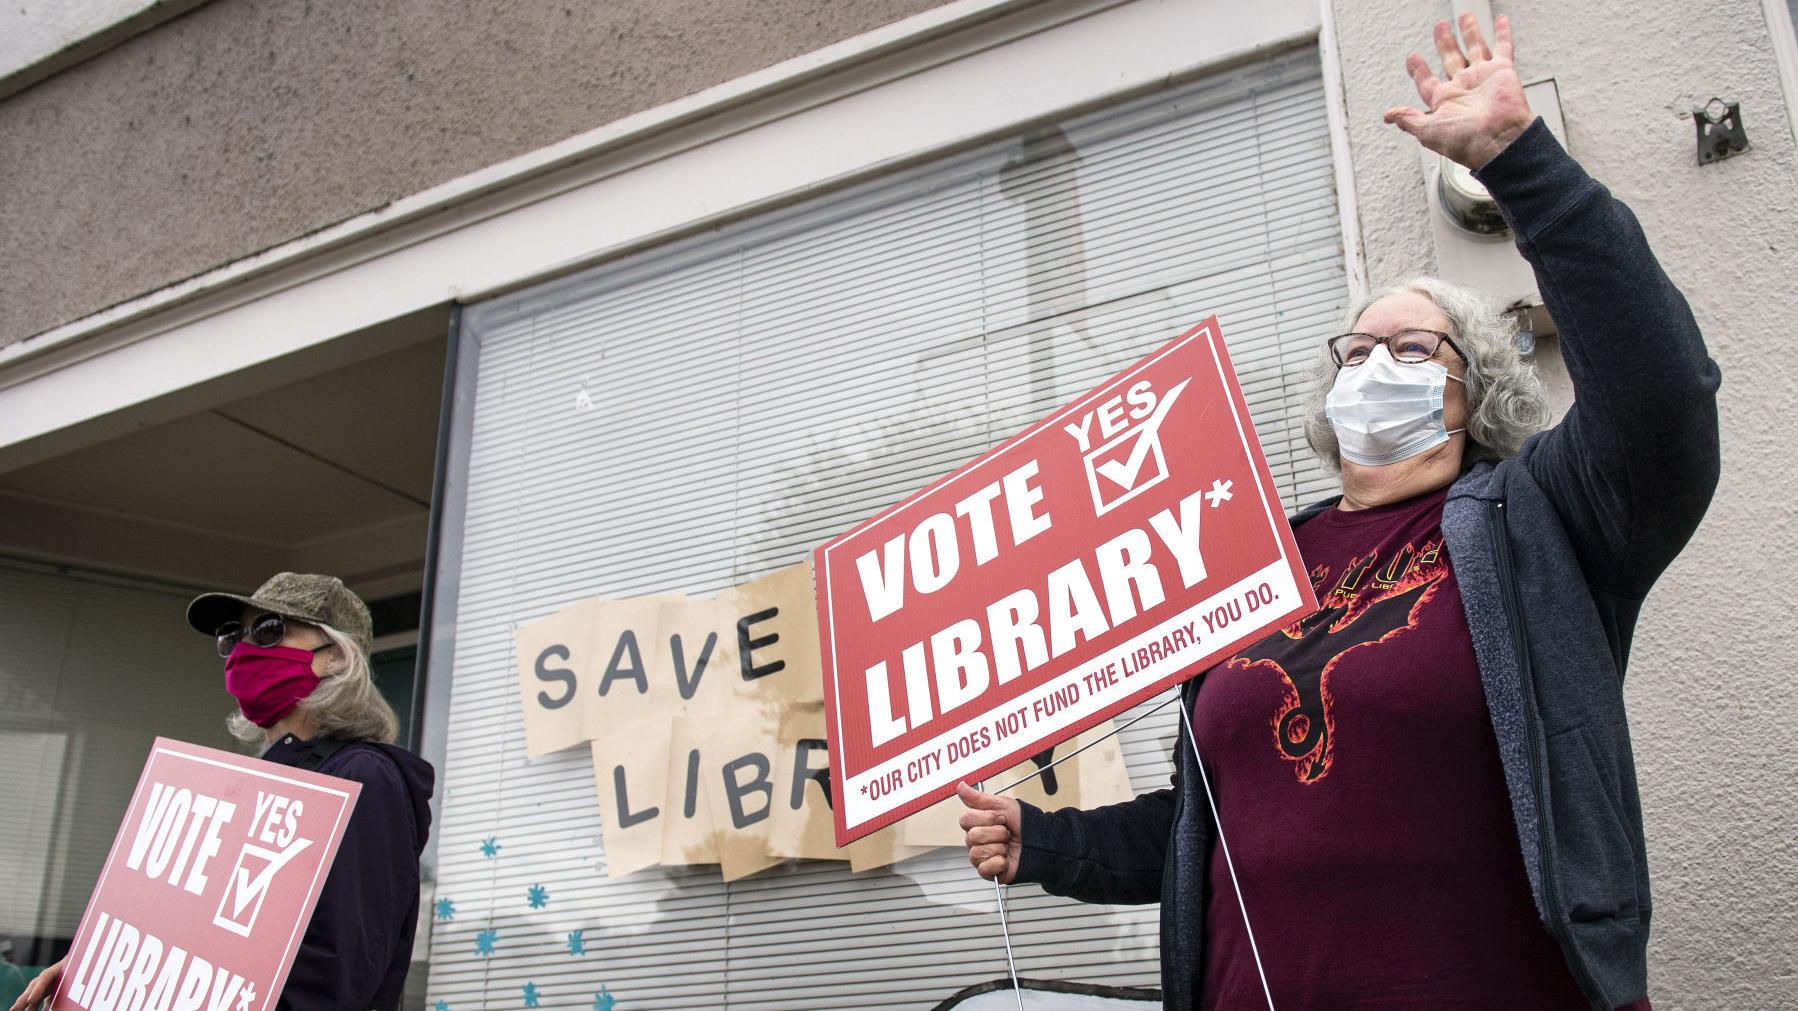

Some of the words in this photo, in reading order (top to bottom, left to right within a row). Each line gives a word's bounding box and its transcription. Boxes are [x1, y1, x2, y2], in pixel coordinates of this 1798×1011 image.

[1064, 380, 1158, 452] YES
[856, 459, 1053, 624] VOTE
[534, 607, 786, 711] SAVE
[908, 751, 942, 784] CITY
[947, 726, 991, 765] DOES
[995, 706, 1030, 740] NOT
[1033, 682, 1081, 722] FUND
[1083, 662, 1119, 696] THE
[1121, 626, 1202, 678] LIBRARY,
[1203, 601, 1243, 634] YOU
[1245, 581, 1280, 614] DO.
[126, 782, 237, 896] VOTE
[247, 790, 304, 848] YES
